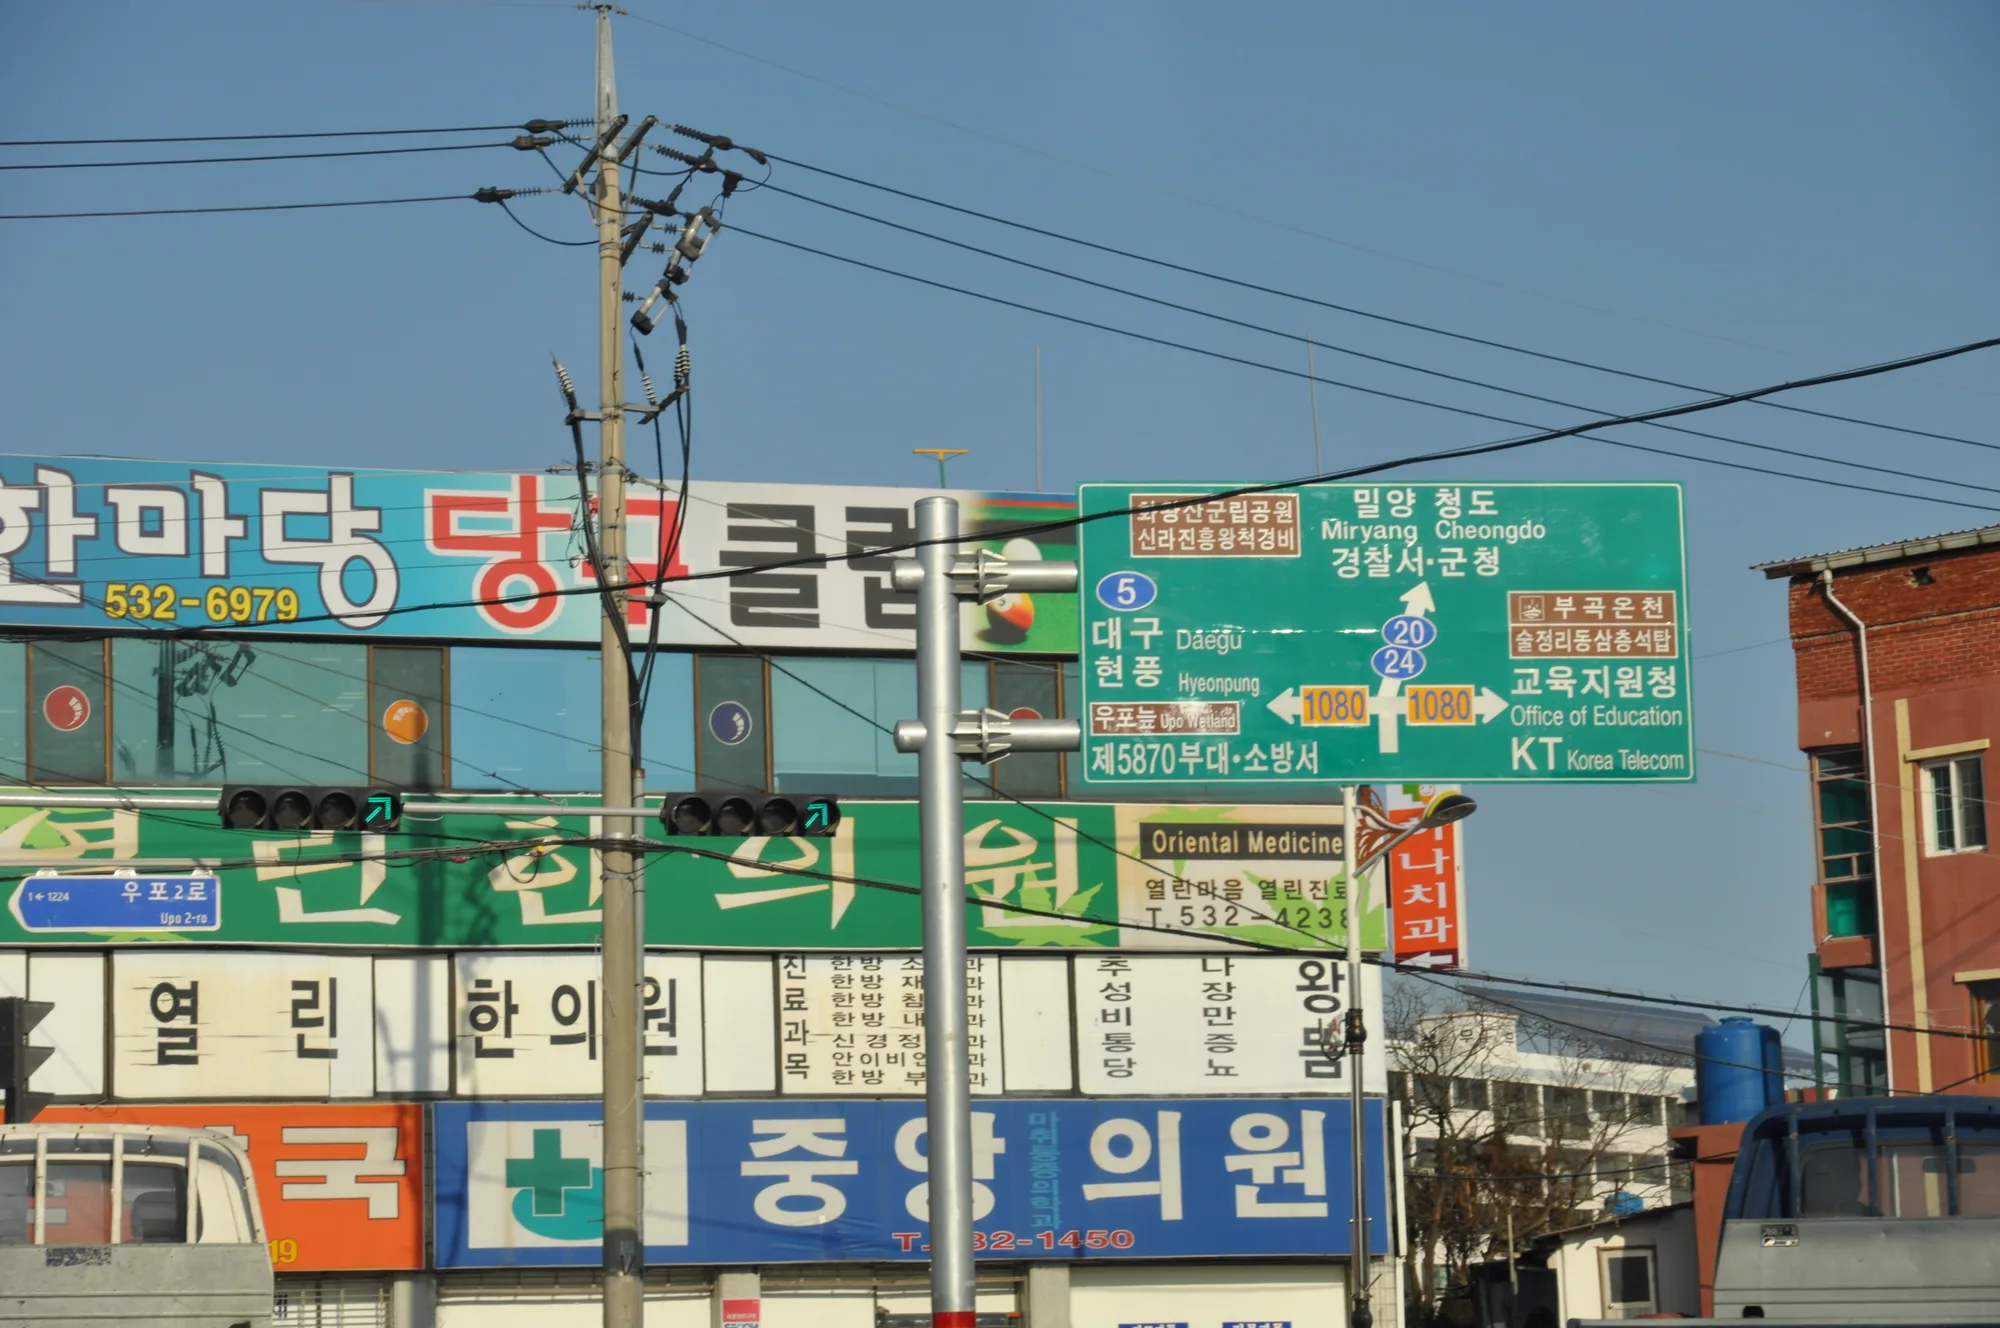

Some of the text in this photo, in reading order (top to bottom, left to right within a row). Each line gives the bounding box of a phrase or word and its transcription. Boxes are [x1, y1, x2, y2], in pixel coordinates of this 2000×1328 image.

[1354, 488, 1498, 518] 밀양 청도
[1137, 527, 1294, 550] 신라진흥왕척경비
[1321, 520, 1546, 544] Miryang Cheongdo
[105, 583, 298, 623] 532-6979
[1117, 577, 1137, 605] 5
[1553, 596, 1663, 618] 부곡온천
[1092, 617, 1163, 650] 대구
[1176, 629, 1242, 654] Daegu
[1394, 620, 1425, 645] 20
[1515, 629, 1671, 653] 술정리동삼층석탑
[1094, 655, 1163, 688] 현풍
[1384, 649, 1415, 674] 24
[1178, 673, 1260, 697] Hyeonpung
[1510, 666, 1677, 698] 교육지원청
[1305, 690, 1365, 721] 1080
[1409, 690, 1471, 720] 1080
[1510, 704, 1683, 727] Office of Education
[1095, 706, 1157, 730] 우포늪
[1160, 711, 1235, 731] Upo Wetland
[1511, 737, 1684, 770] KT Korea Telecom
[1152, 829, 1344, 855] Oriental Medicine
[48, 892, 70, 902] 1224
[1146, 879, 1244, 901] 열린마음
[161, 912, 208, 925] Upo 2-ro
[829, 956, 984, 972] 한방 소과
[830, 974, 883, 990] 한방
[832, 992, 985, 1009] 한방 침과
[150, 976, 337, 1066] 열린
[783, 954, 811, 1080] 진료과목
[832, 1011, 885, 1028] 한방
[832, 1069, 989, 1087] 한방 부과
